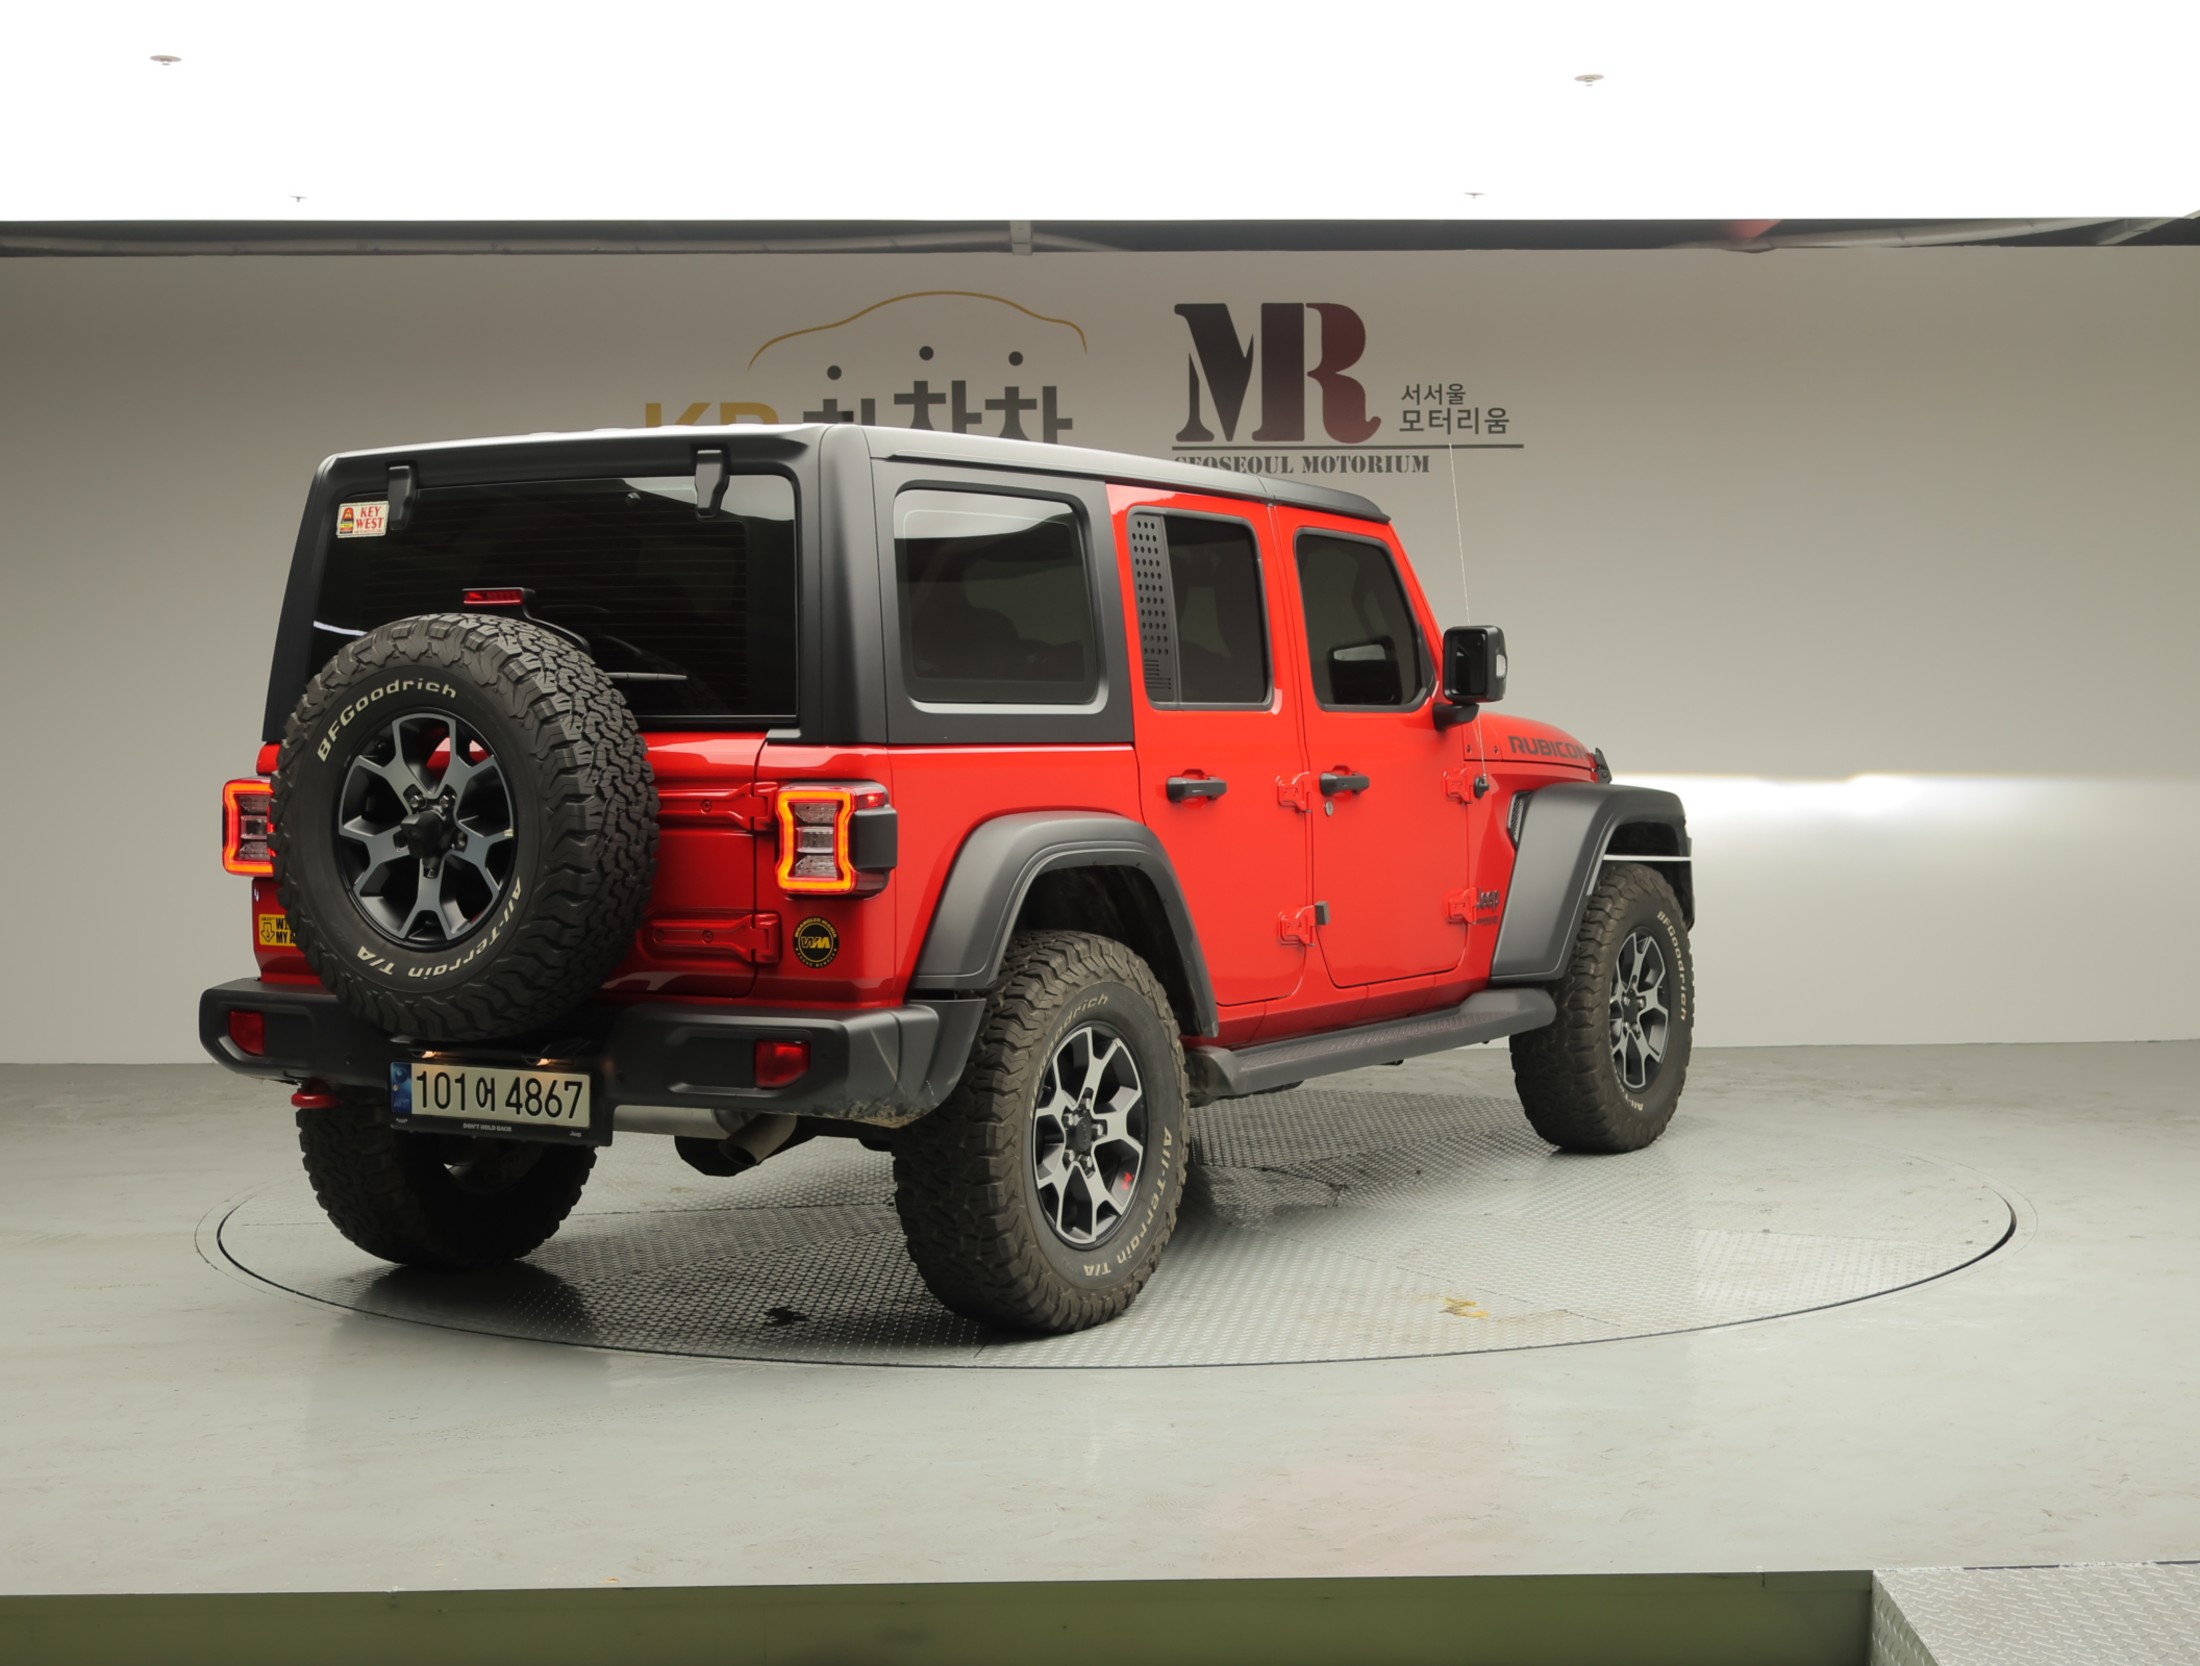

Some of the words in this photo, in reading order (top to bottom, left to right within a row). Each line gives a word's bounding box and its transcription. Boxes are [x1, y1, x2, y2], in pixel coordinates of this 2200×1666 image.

[1174, 302, 1382, 444] MR
[1401, 383, 1466, 405] 서서울
[1399, 407, 1510, 435] 모터리움
[1301, 455, 1430, 474] MOTORIUM
[356, 517, 384, 529] WEST
[360, 506, 381, 517] KEY
[317, 678, 457, 762] BFGoodrich
[1508, 735, 1588, 759] RUBICON
[408, 876, 522, 980] All-Terrain
[357, 945, 396, 976] T/A
[1656, 910, 1688, 1021] BFGoodrich
[1117, 1126, 1172, 1264] All-Terrain
[1083, 1262, 1112, 1276] T/A
